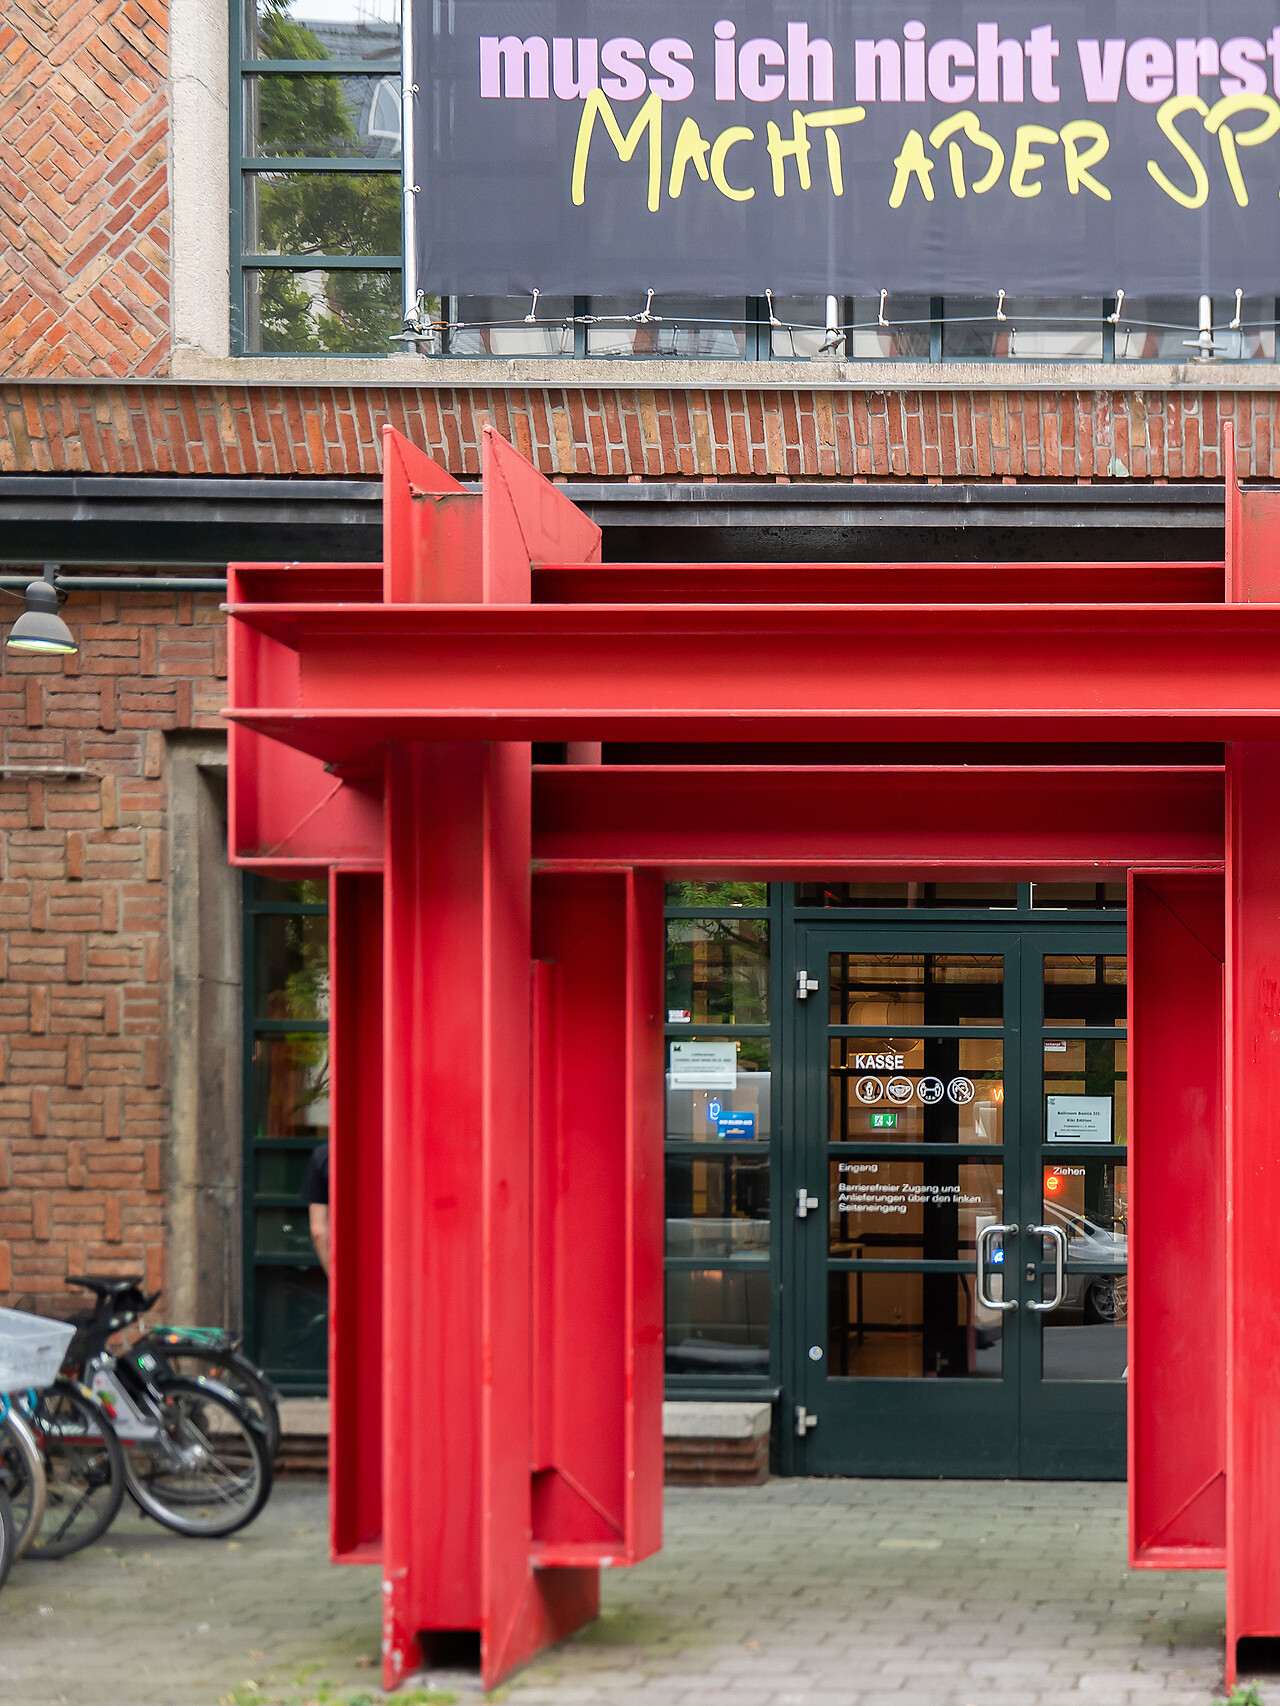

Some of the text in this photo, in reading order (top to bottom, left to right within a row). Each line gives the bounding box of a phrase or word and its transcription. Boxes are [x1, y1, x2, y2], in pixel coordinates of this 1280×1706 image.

[479, 35, 694, 101] muss
[714, 19, 833, 102] ich
[855, 19, 1060, 103] nicht
[571, 87, 866, 212] MACHT
[889, 110, 1112, 208] ABER
[855, 1054, 905, 1070] KASSE
[838, 1163, 878, 1174] Eingang
[1053, 1166, 1086, 1176] Ziehen
[838, 1183, 961, 1194] Barrierefreier Zugang und
[838, 1193, 982, 1205] Anlieferungen über den linken
[838, 1203, 907, 1215] Seiteneingang
